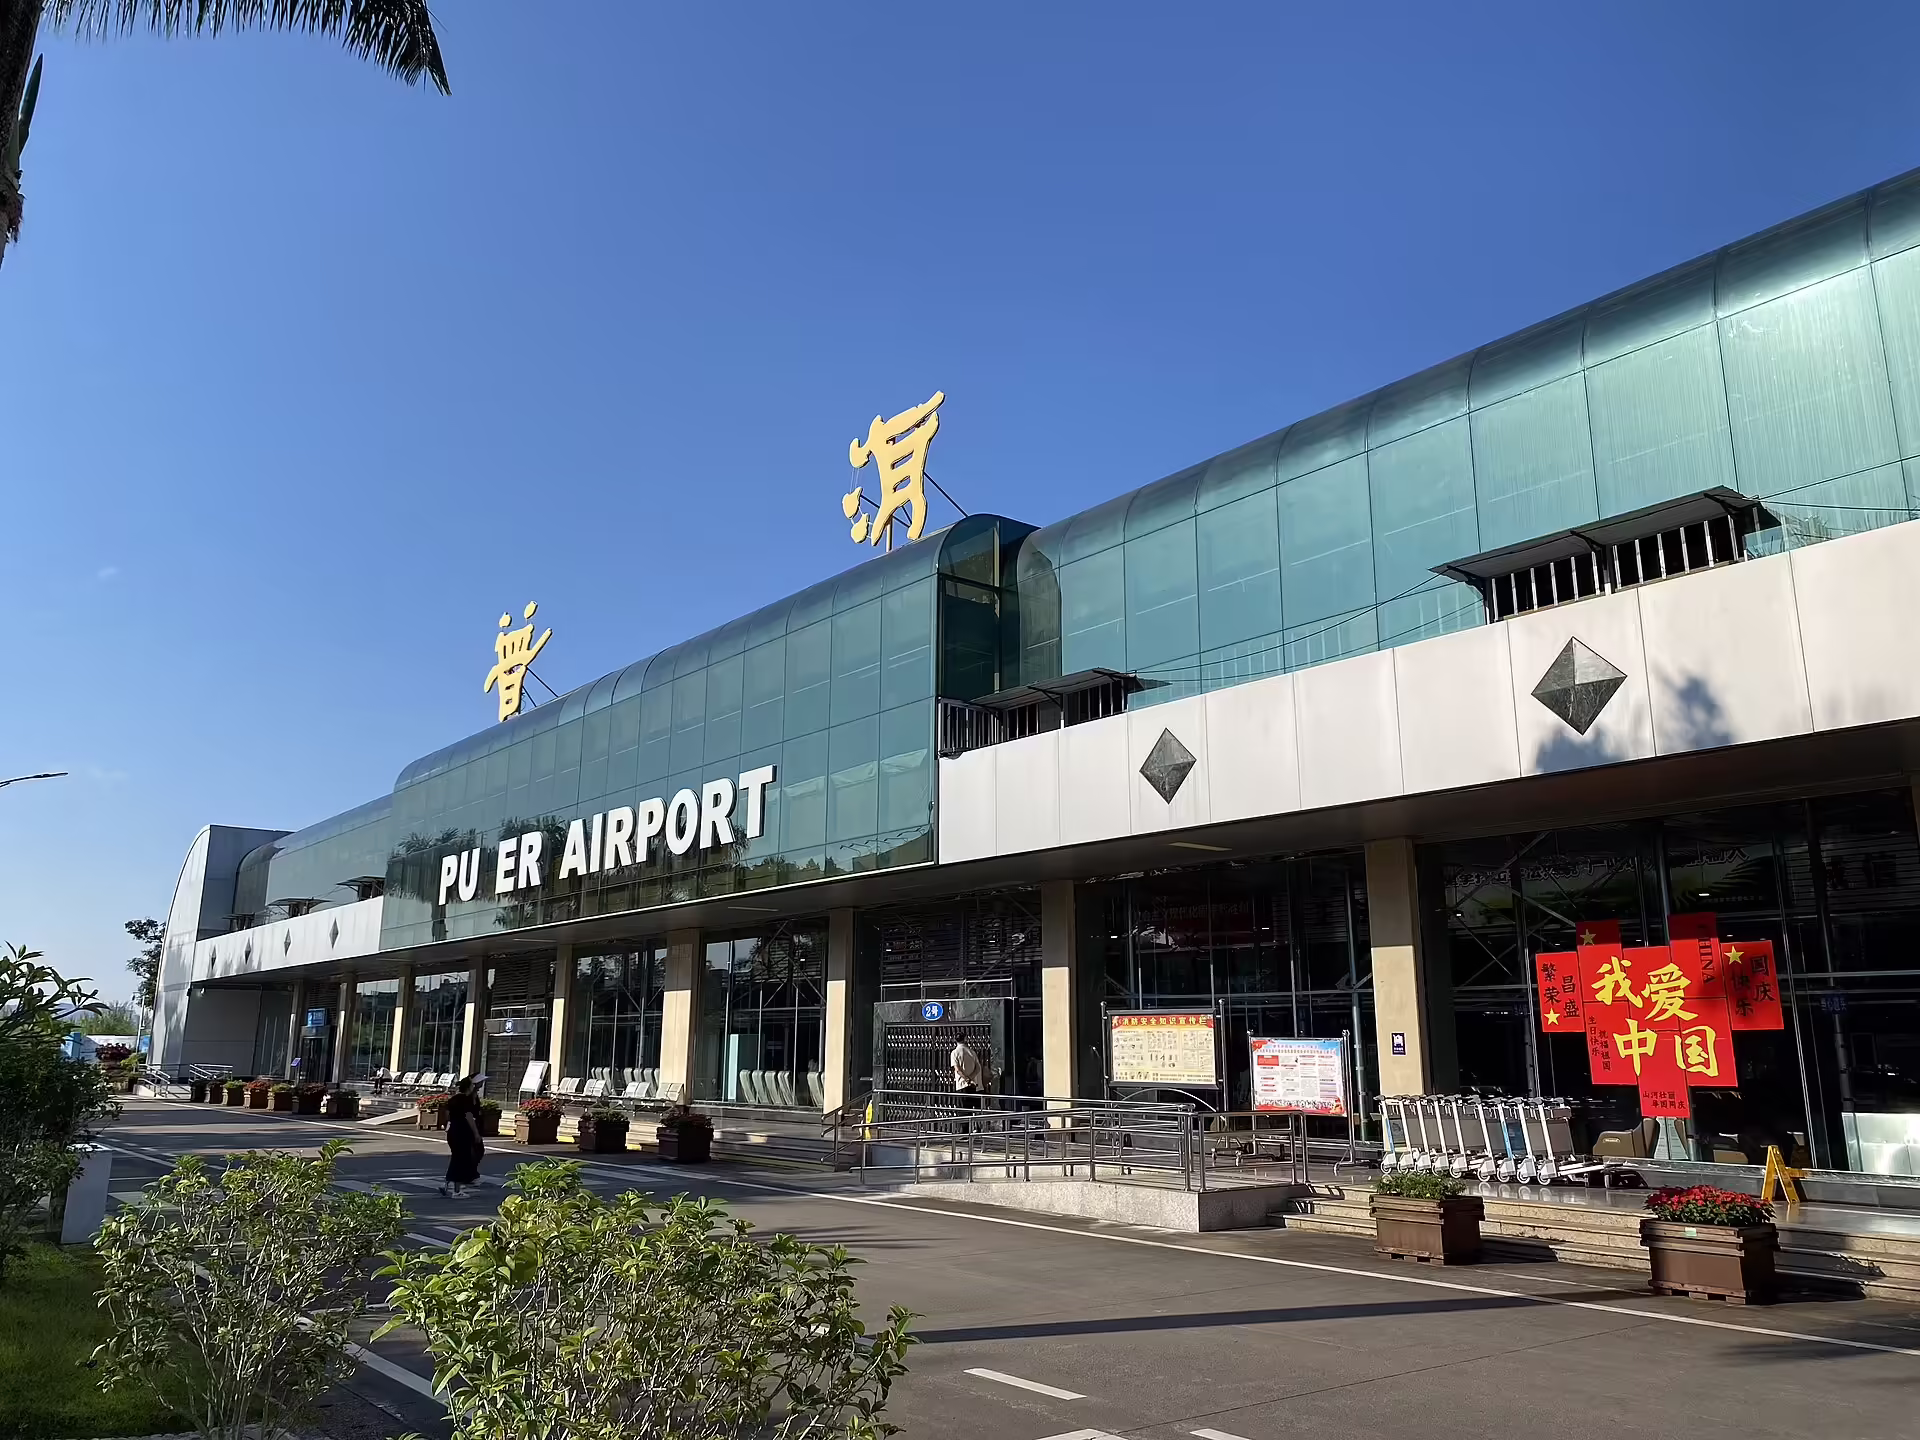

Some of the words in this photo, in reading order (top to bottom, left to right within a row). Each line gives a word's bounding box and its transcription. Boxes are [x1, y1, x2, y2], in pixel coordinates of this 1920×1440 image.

[438, 848, 480, 906] PU
[495, 831, 544, 894] ER
[558, 764, 777, 880] AIRPORT
[1698, 923, 1717, 983] HINA
[1750, 955, 1776, 1002] 国庆
[1541, 962, 1561, 1006] 繁荣
[1561, 975, 1580, 1019] 昌盛
[1591, 956, 1699, 1022] 我爱
[1588, 1015, 1600, 1056] 生日快乐
[1613, 1018, 1719, 1077] 中国
